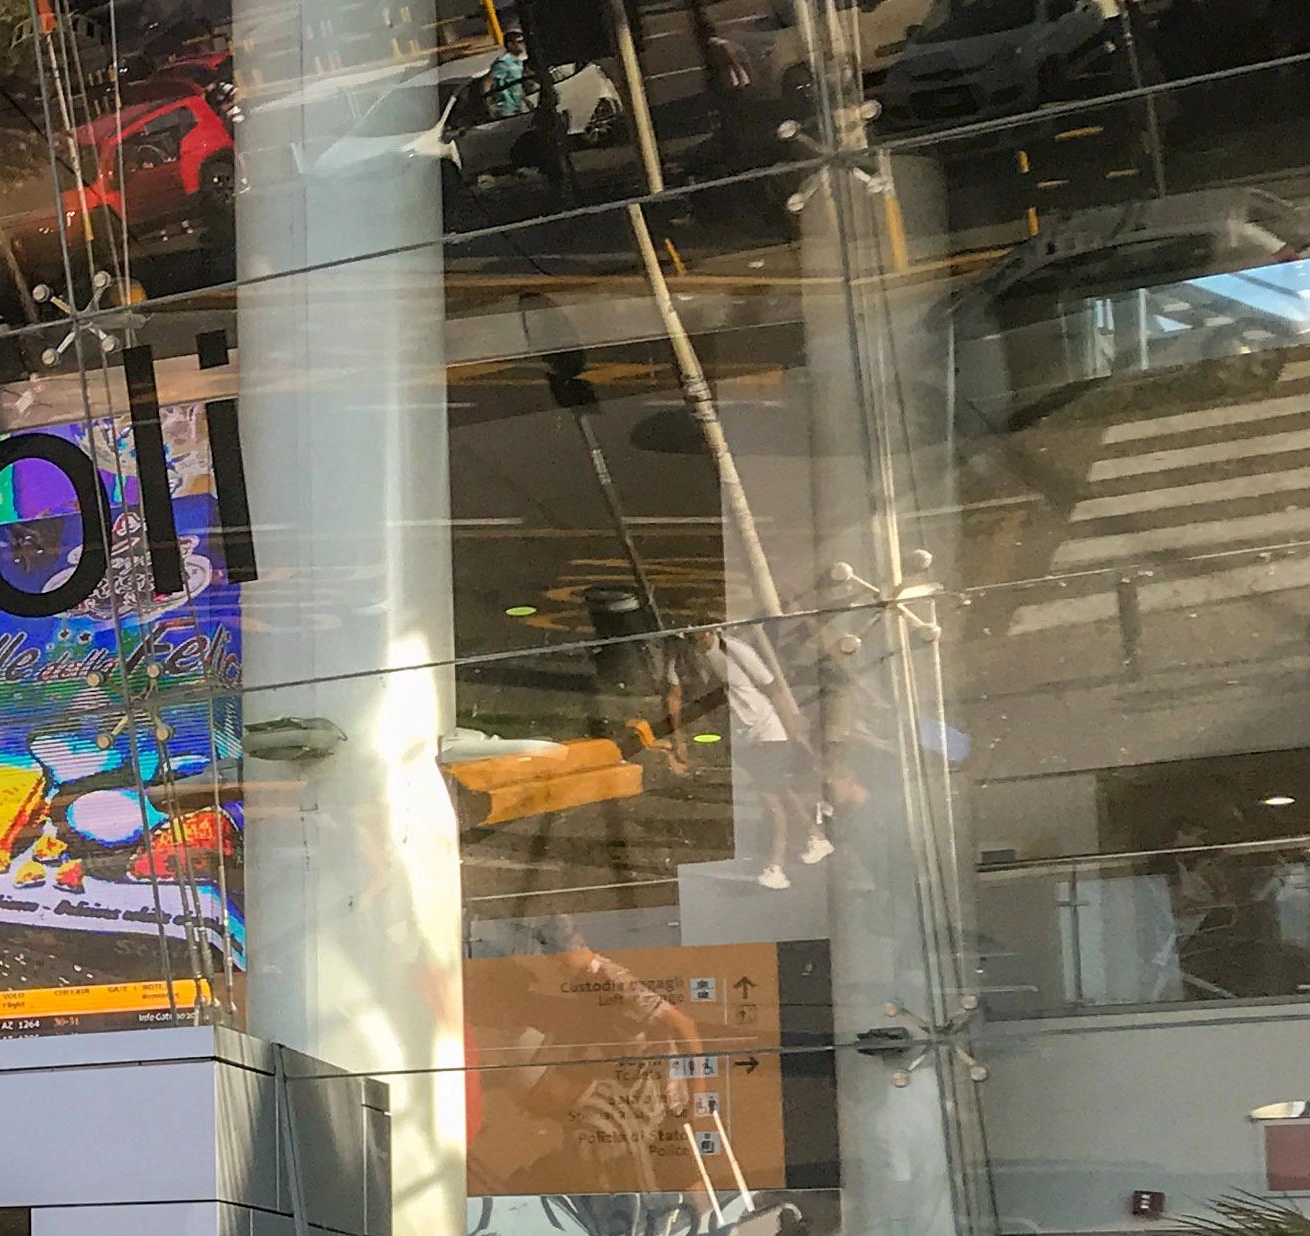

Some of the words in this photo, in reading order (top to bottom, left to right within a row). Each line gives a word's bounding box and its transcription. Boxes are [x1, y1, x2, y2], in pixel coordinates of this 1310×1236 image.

[559, 980, 624, 994] Custodia
[1, 1021, 14, 1031] AZ
[18, 1019, 41, 1030] 1264
